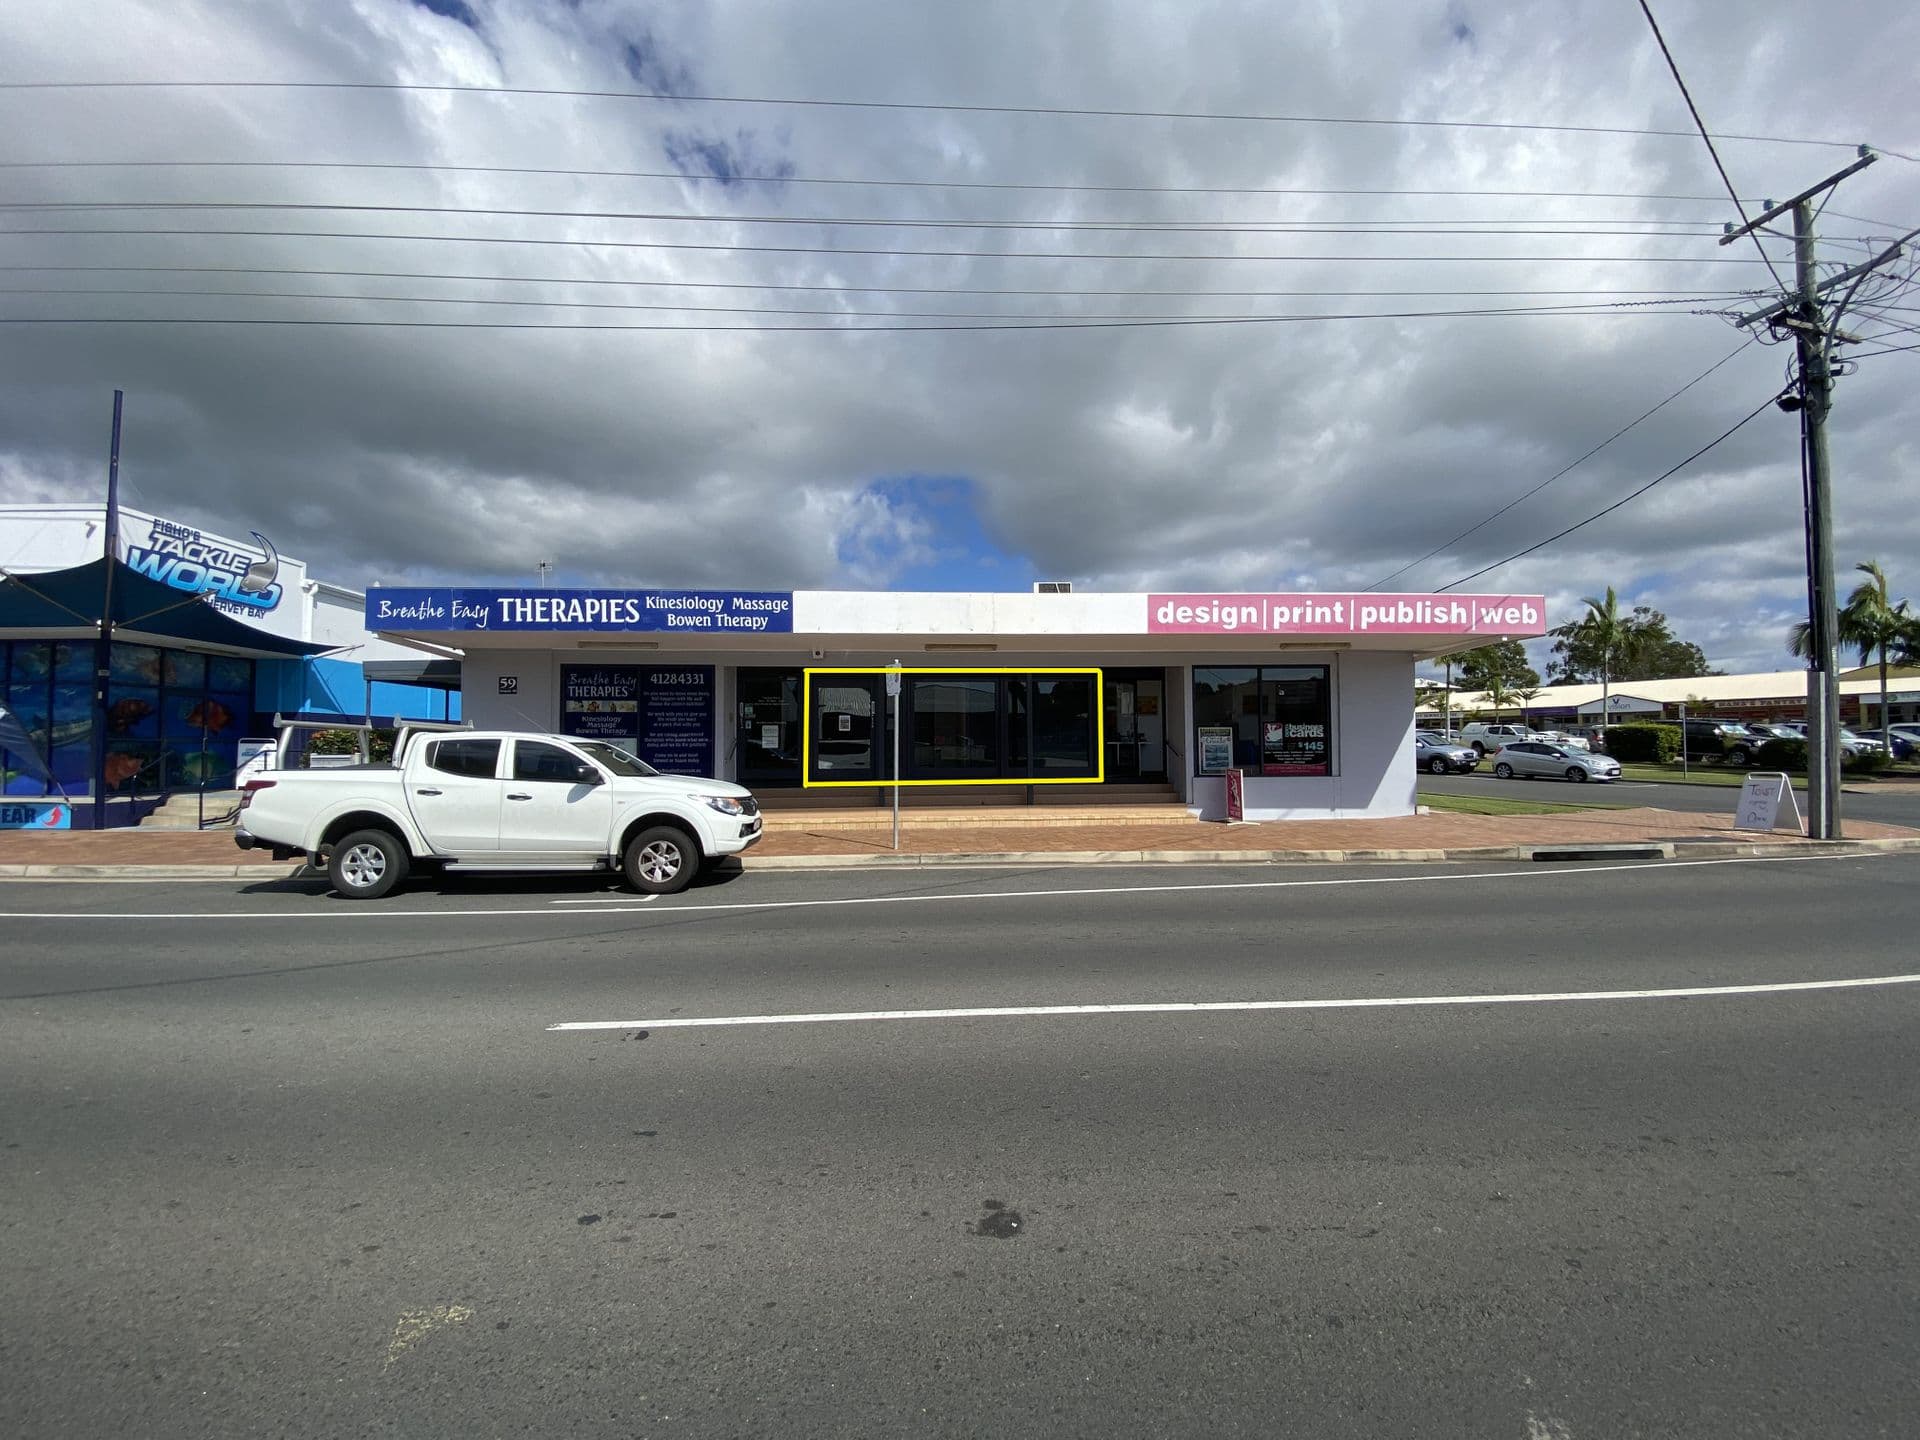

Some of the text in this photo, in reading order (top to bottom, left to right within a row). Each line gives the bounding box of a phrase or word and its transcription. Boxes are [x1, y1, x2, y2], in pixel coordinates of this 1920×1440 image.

[150, 531, 250, 574] TACKLE
[128, 547, 281, 608] WORLD
[248, 602, 266, 620] BAY
[378, 597, 640, 628] Breathe Easy THERAPIES
[646, 595, 789, 614] Kinesiology Massage
[668, 612, 769, 630] Bowen Therapy
[1157, 599, 1538, 631] design print publish web
[500, 678, 516, 689] 59
[650, 673, 705, 685] 41284331
[568, 685, 629, 697] THERAPIES
[1289, 728, 1324, 738] cards
[1298, 742, 1324, 751] $145
[0, 808, 36, 823] EAR
